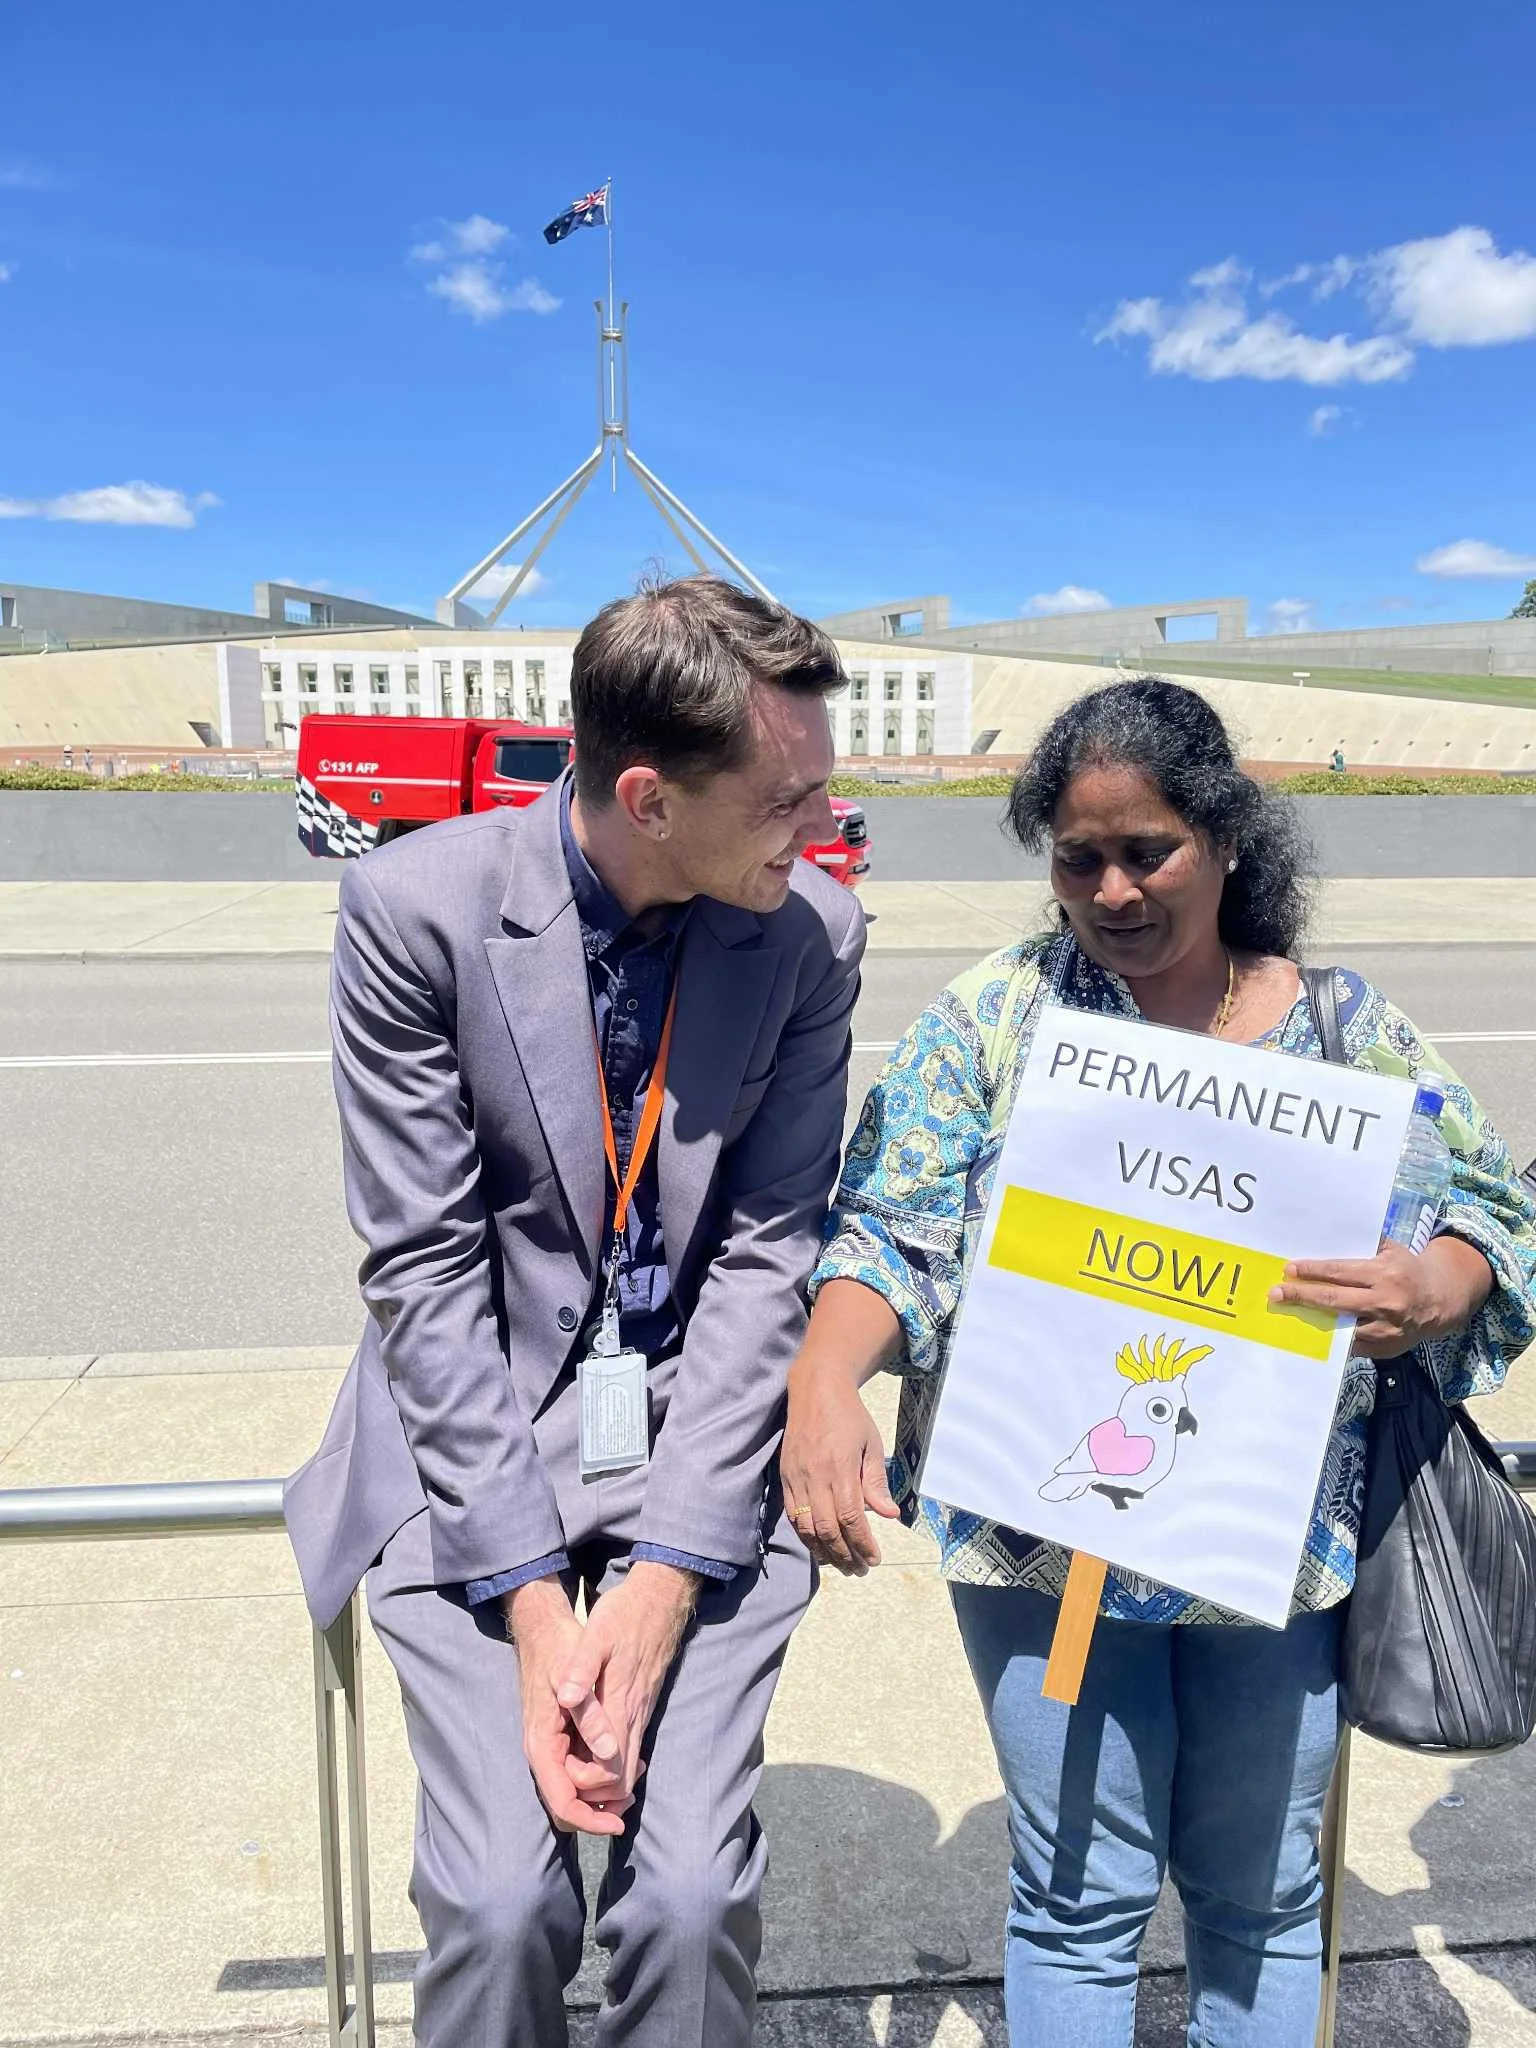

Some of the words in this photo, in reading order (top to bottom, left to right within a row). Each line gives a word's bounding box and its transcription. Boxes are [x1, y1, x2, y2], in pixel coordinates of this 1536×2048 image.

[331, 761, 353, 773] 131
[355, 761, 379, 774] AFP
[1049, 1041, 1382, 1152] PERMANENT
[1118, 1140, 1258, 1214] VISAS
[1086, 1227, 1242, 1306] NOW!
